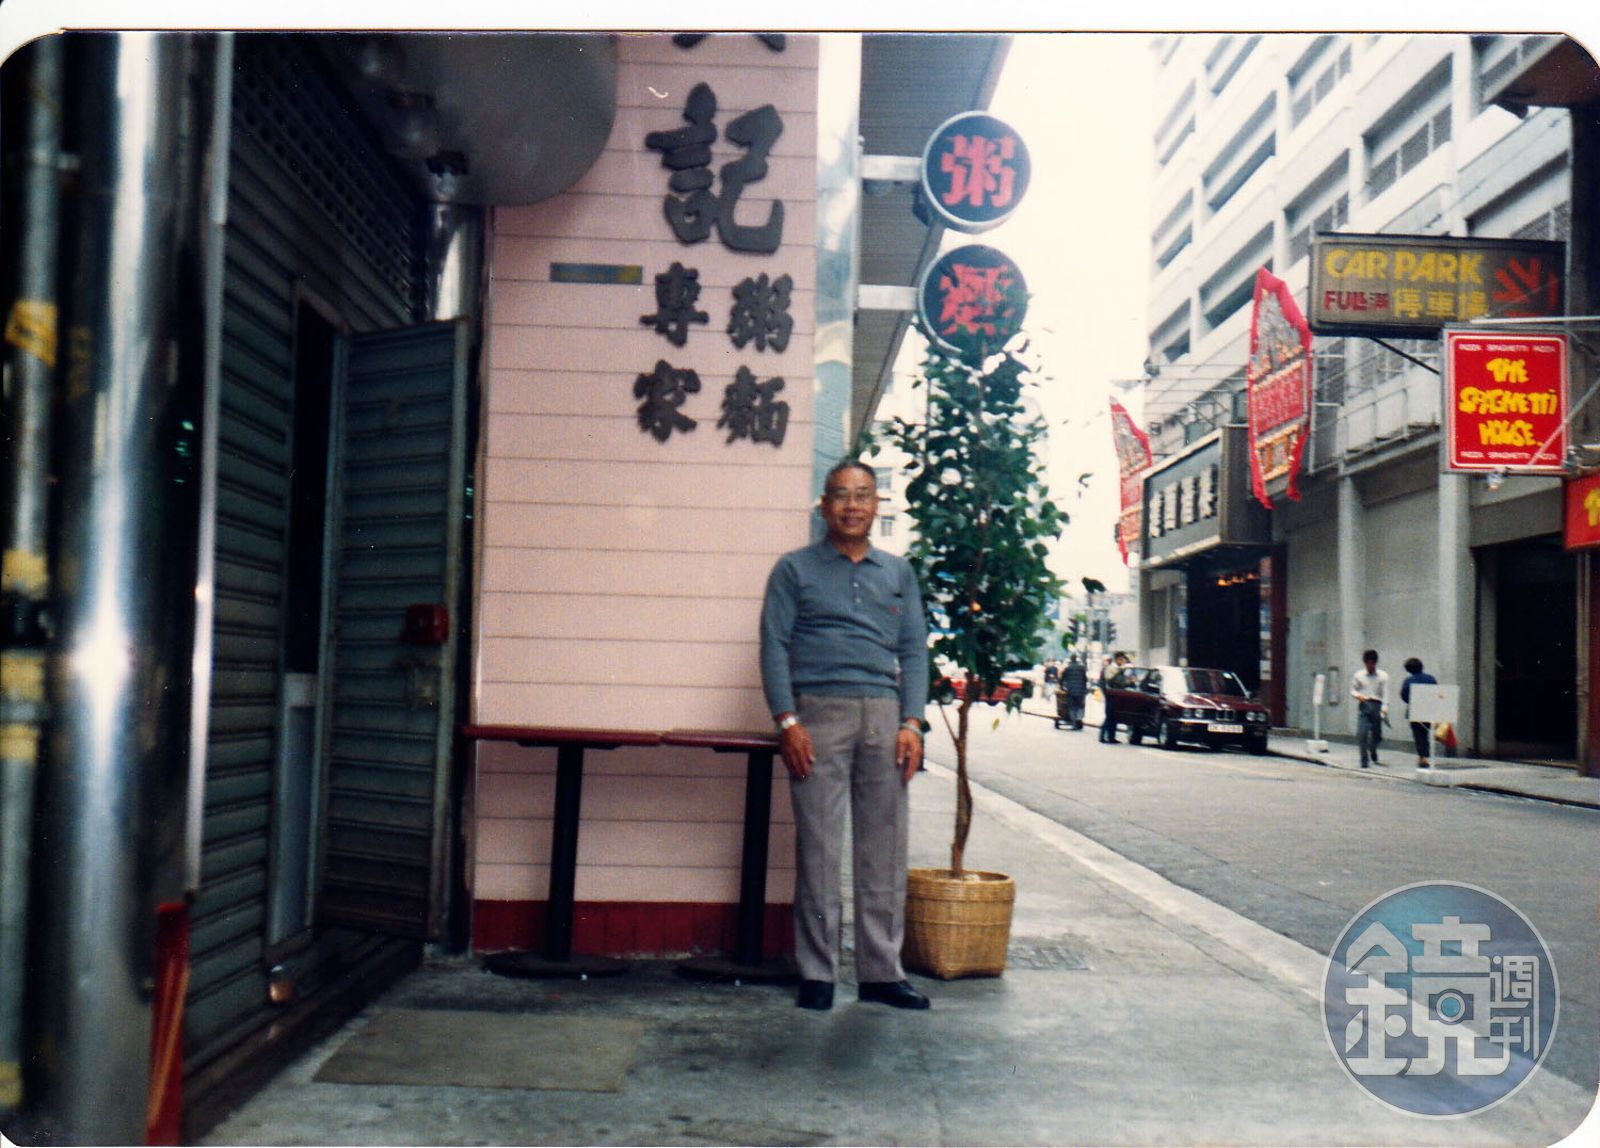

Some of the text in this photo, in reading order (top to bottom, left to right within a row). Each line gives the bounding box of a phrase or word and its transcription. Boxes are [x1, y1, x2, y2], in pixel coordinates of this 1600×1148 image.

[941, 133, 1015, 207] 粥
[1325, 249, 1484, 284] CAR PARK
[1486, 357, 1529, 383] THE
